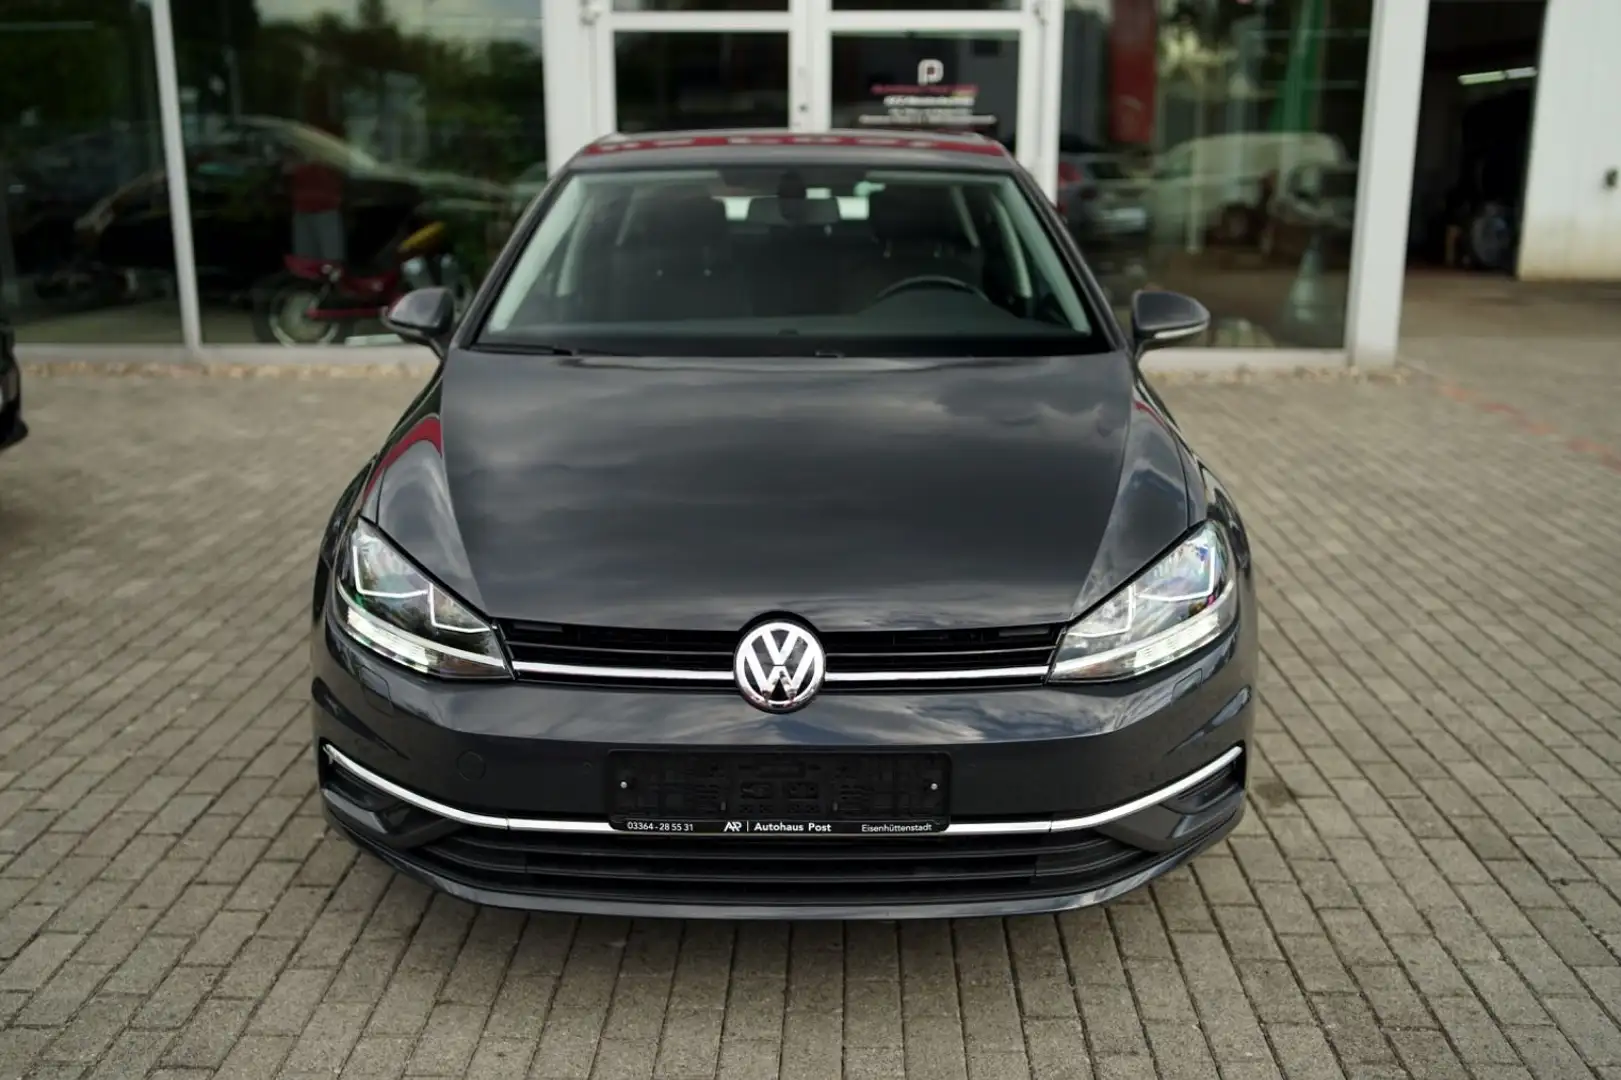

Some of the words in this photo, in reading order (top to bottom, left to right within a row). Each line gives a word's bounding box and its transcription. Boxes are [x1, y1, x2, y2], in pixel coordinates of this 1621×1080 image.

[738, 624, 821, 706] VW
[754, 822, 804, 832] Autohaus
[808, 822, 832, 832] Post
[861, 823, 932, 833] Eisenhüttenstadt
